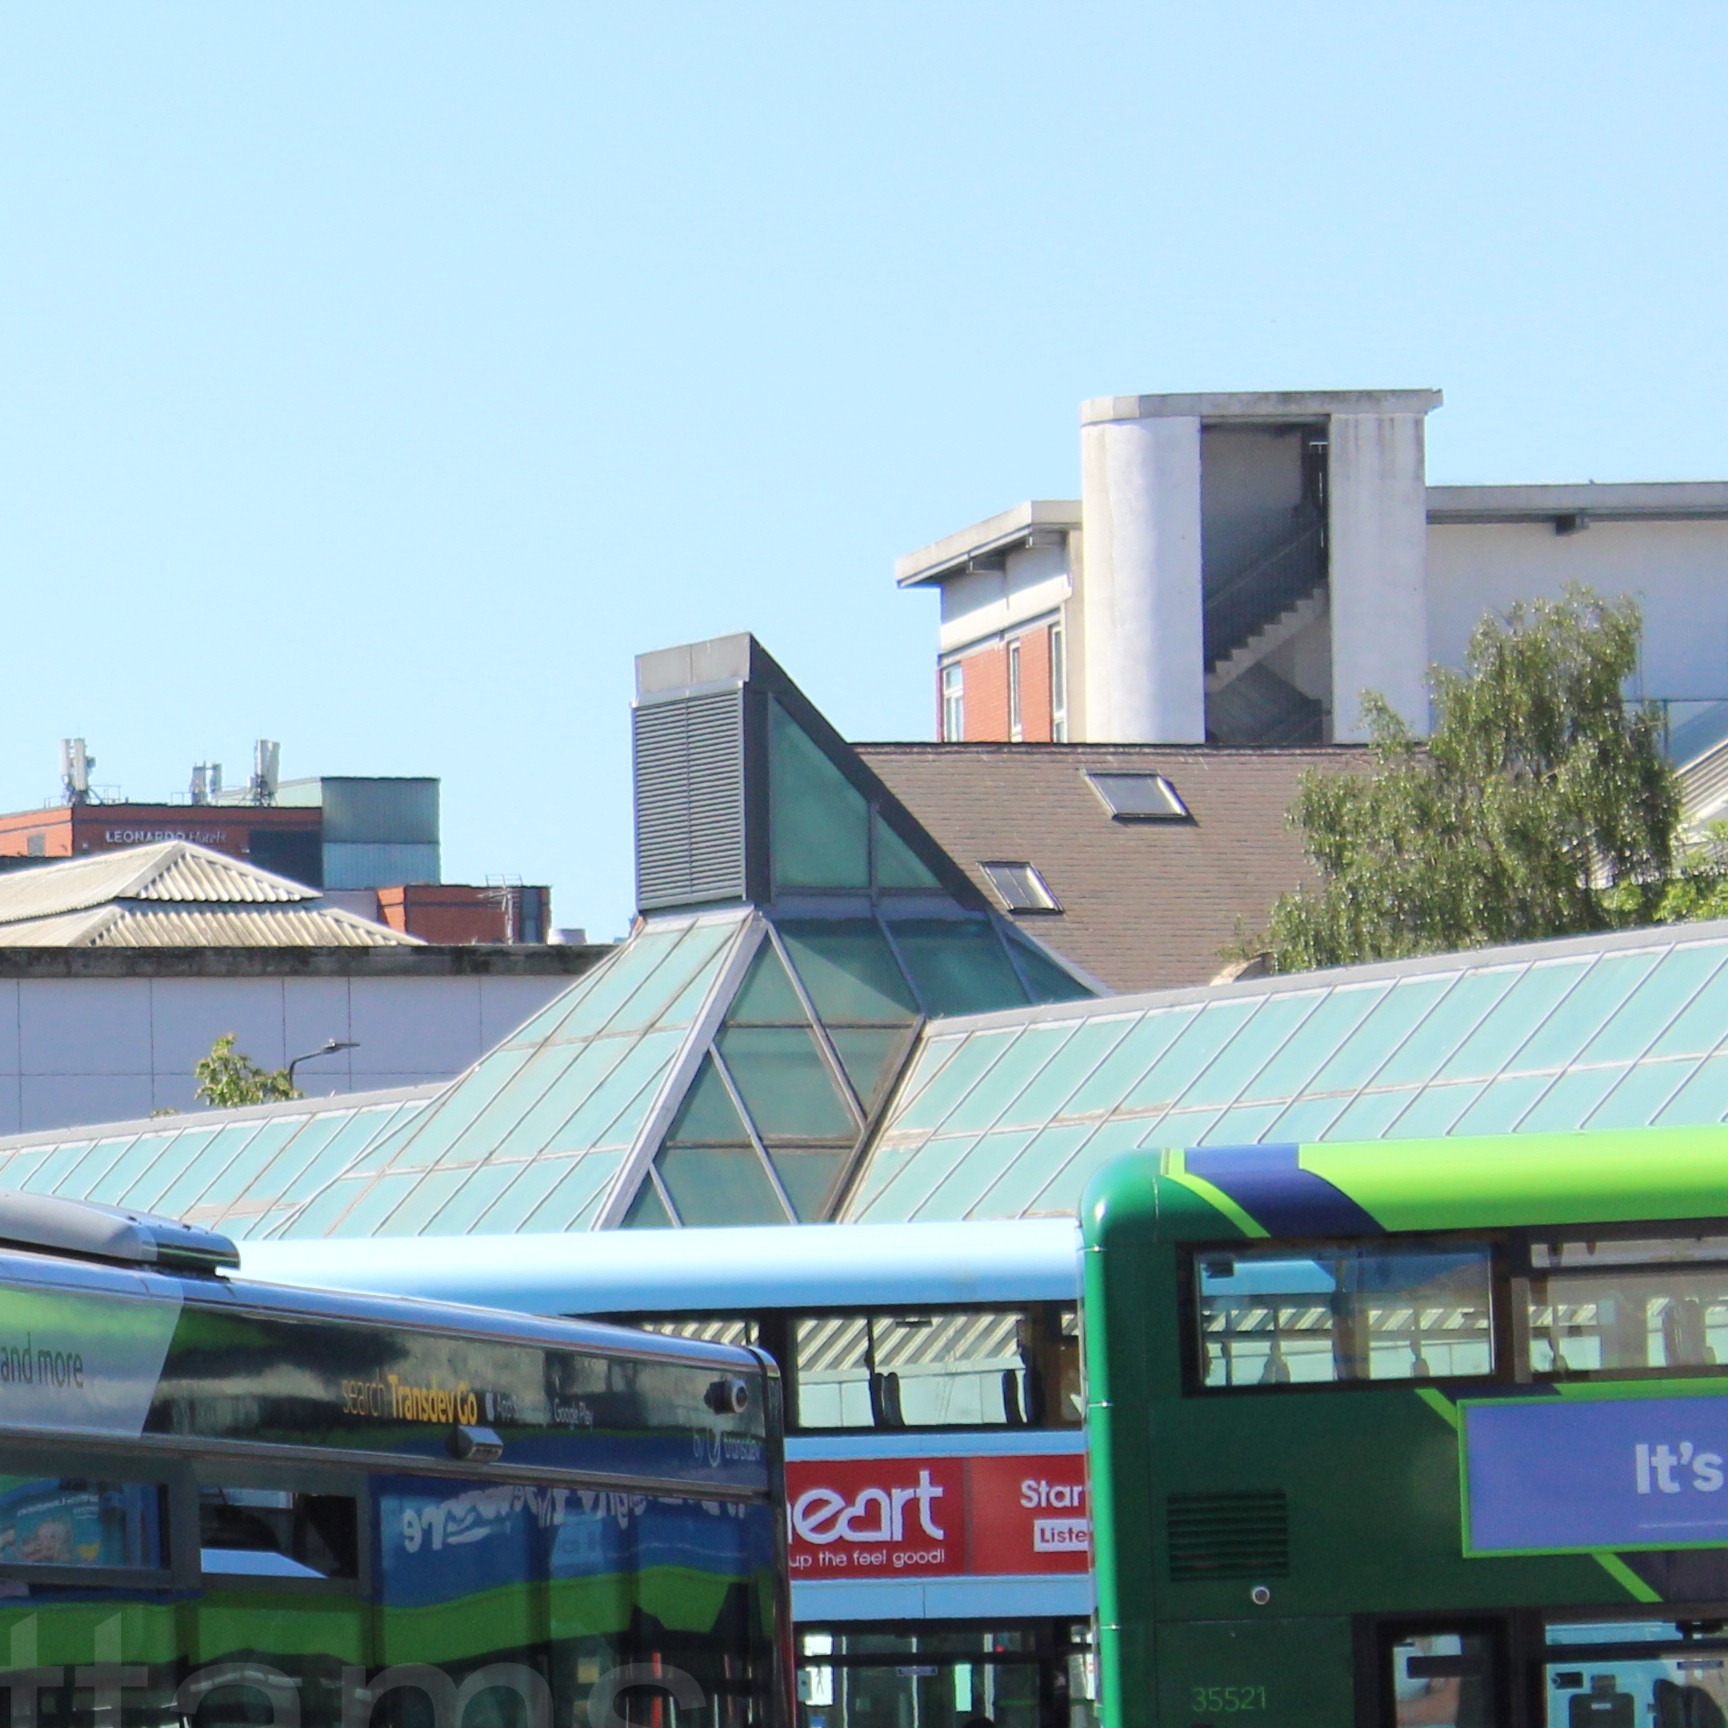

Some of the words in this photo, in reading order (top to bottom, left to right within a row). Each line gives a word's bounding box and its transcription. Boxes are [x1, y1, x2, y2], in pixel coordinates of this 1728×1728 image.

[105, 830, 185, 843] LEONARDO
[0, 1330, 33, 1384] and
[37, 1348, 85, 1389] more
[387, 1374, 455, 1424] Transdev
[456, 1381, 478, 1426] Go
[786, 1468, 945, 1545] eart
[1019, 1479, 1088, 1509] Star
[818, 1551, 848, 1567] the
[853, 1549, 887, 1566] feel
[893, 1548, 946, 1568] good!
[1191, 1685, 1266, 1712] 35521
